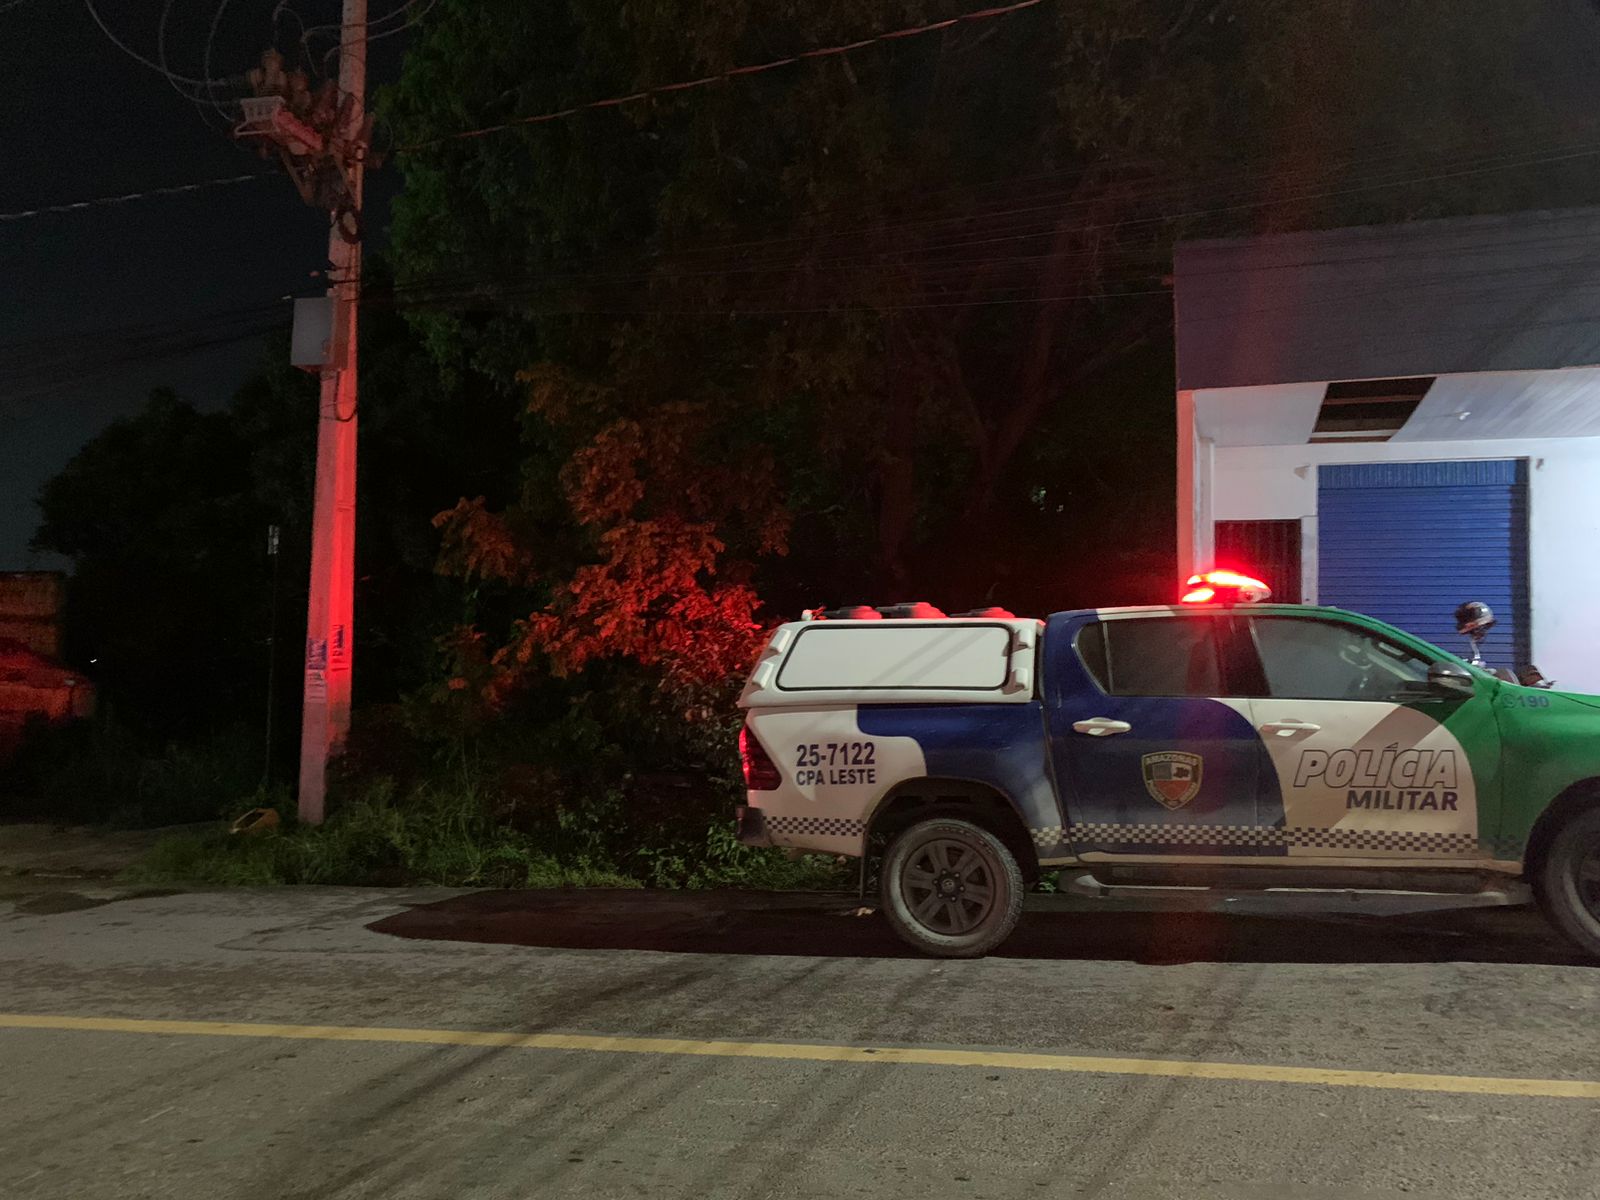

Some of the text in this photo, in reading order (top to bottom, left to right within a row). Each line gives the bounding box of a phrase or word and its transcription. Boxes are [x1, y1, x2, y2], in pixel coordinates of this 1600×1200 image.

[1517, 694, 1549, 708] 190
[796, 742, 876, 767] 25-7122
[1293, 742, 1458, 789] POLÍCIA
[796, 768, 876, 786] CPA LESTE
[1346, 790, 1458, 811] MILITAR
